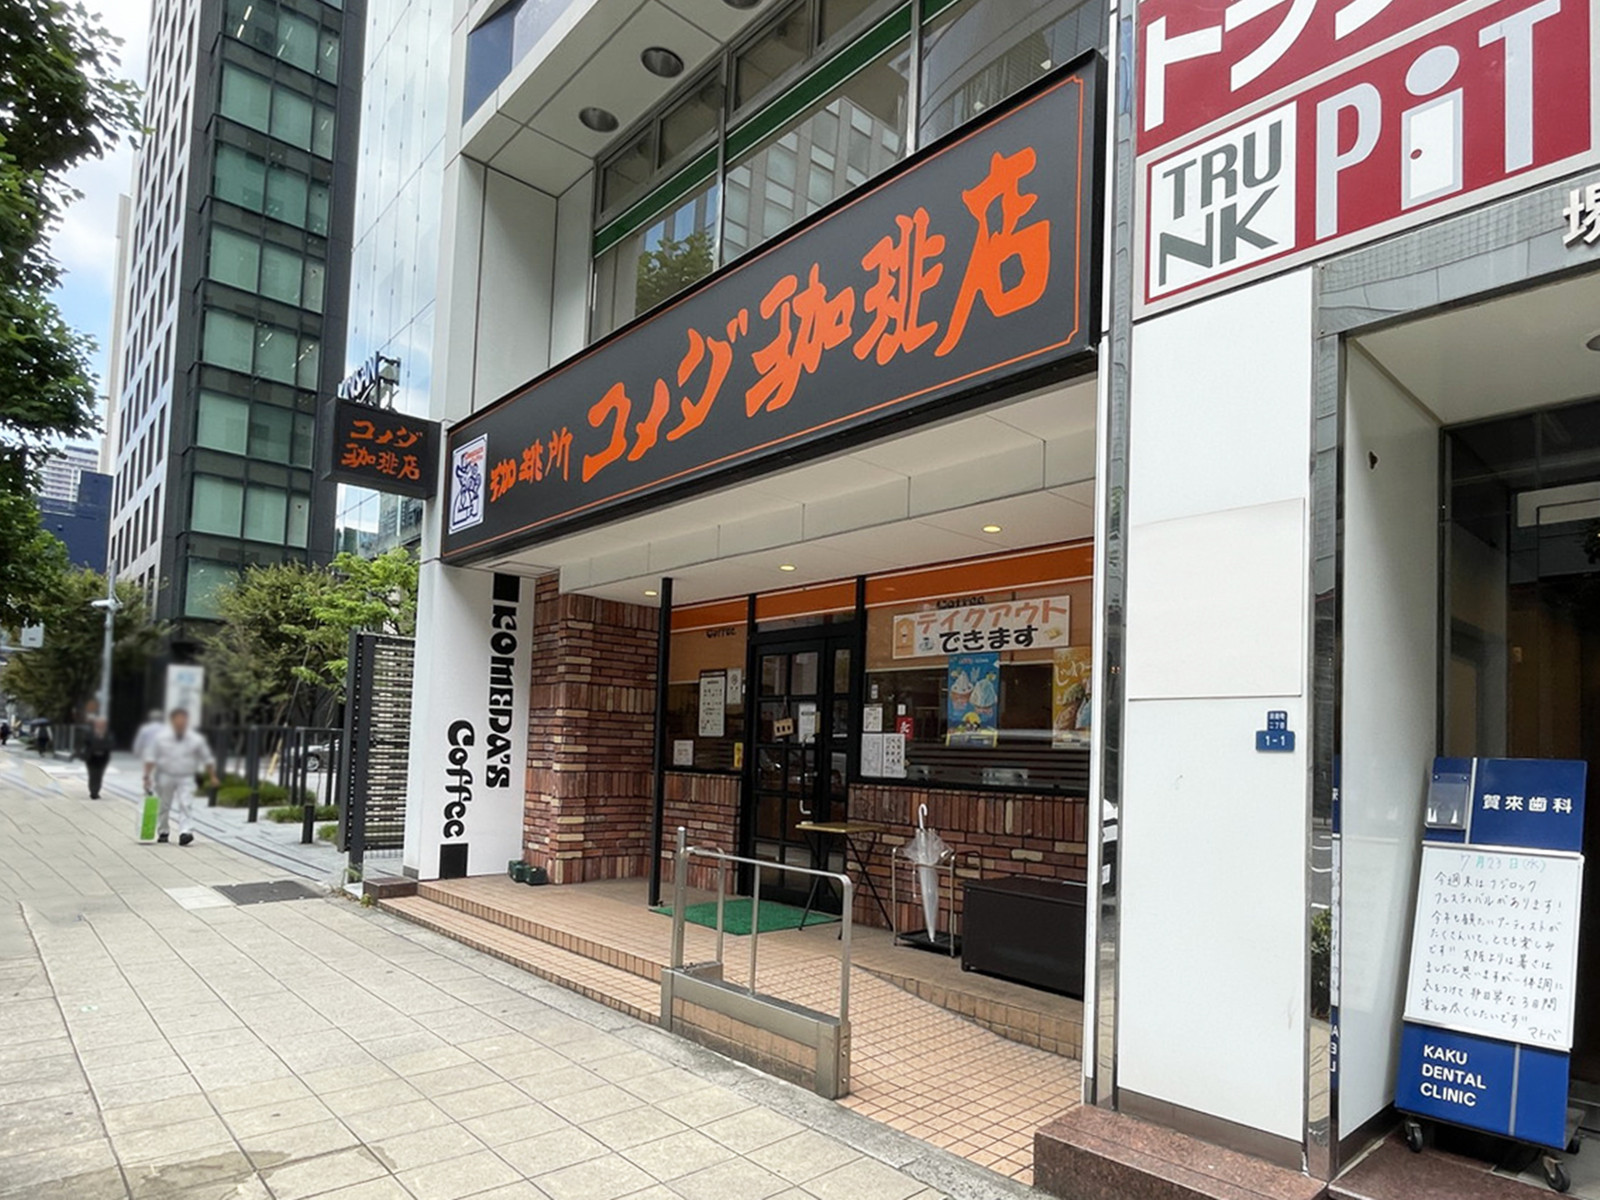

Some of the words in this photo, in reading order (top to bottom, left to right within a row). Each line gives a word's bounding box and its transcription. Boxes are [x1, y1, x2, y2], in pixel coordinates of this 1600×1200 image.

[582, 146, 1052, 483] コメダ珈琲店
[351, 420, 423, 448] コメダ
[341, 443, 421, 480] 珈琲店
[917, 599, 1067, 635] テイクアウト
[939, 624, 1039, 653] できます
[485, 604, 518, 789] KOMEDA'S
[1265, 735, 1286, 747] 1-1
[442, 719, 475, 839] Coffee
[1423, 1044, 1468, 1065] KAKU
[1422, 1063, 1487, 1090] DENTAL
[1420, 1082, 1477, 1107] CLINIC
